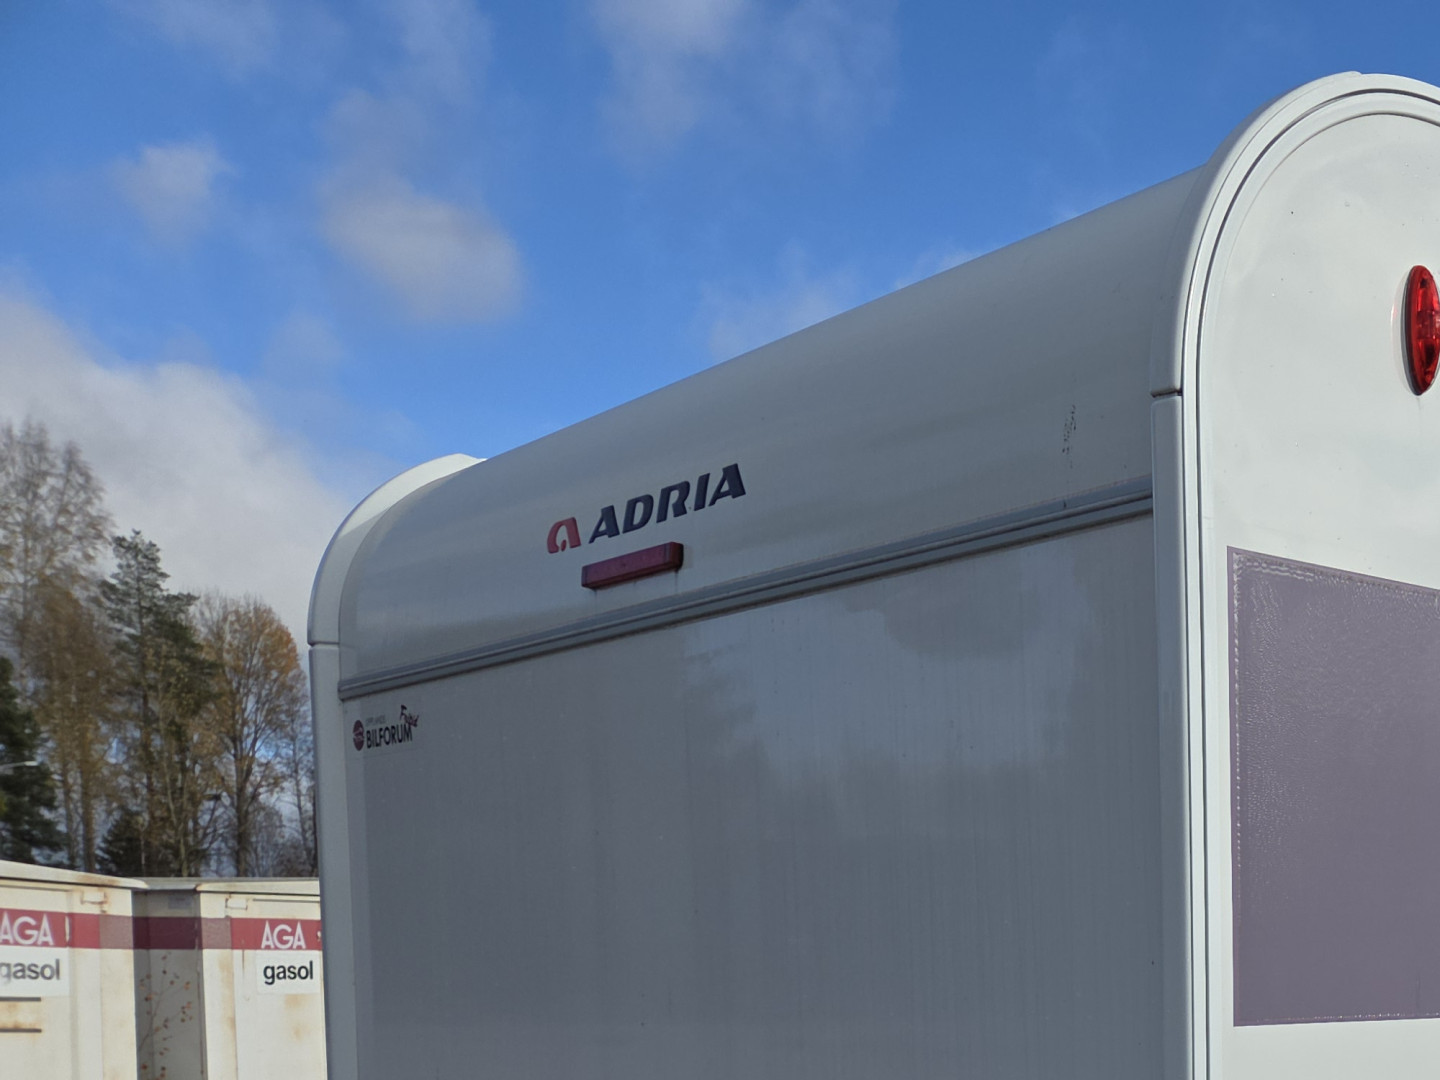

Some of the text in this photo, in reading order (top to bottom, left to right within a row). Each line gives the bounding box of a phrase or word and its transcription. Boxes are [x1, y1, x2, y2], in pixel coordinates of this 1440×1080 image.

[588, 463, 747, 544] ADRIA
[366, 723, 413, 749] BILFORUM
[0, 910, 55, 946] AGA
[261, 920, 306, 950] AGA
[0, 958, 60, 985] gasol
[263, 960, 314, 985] gasol
